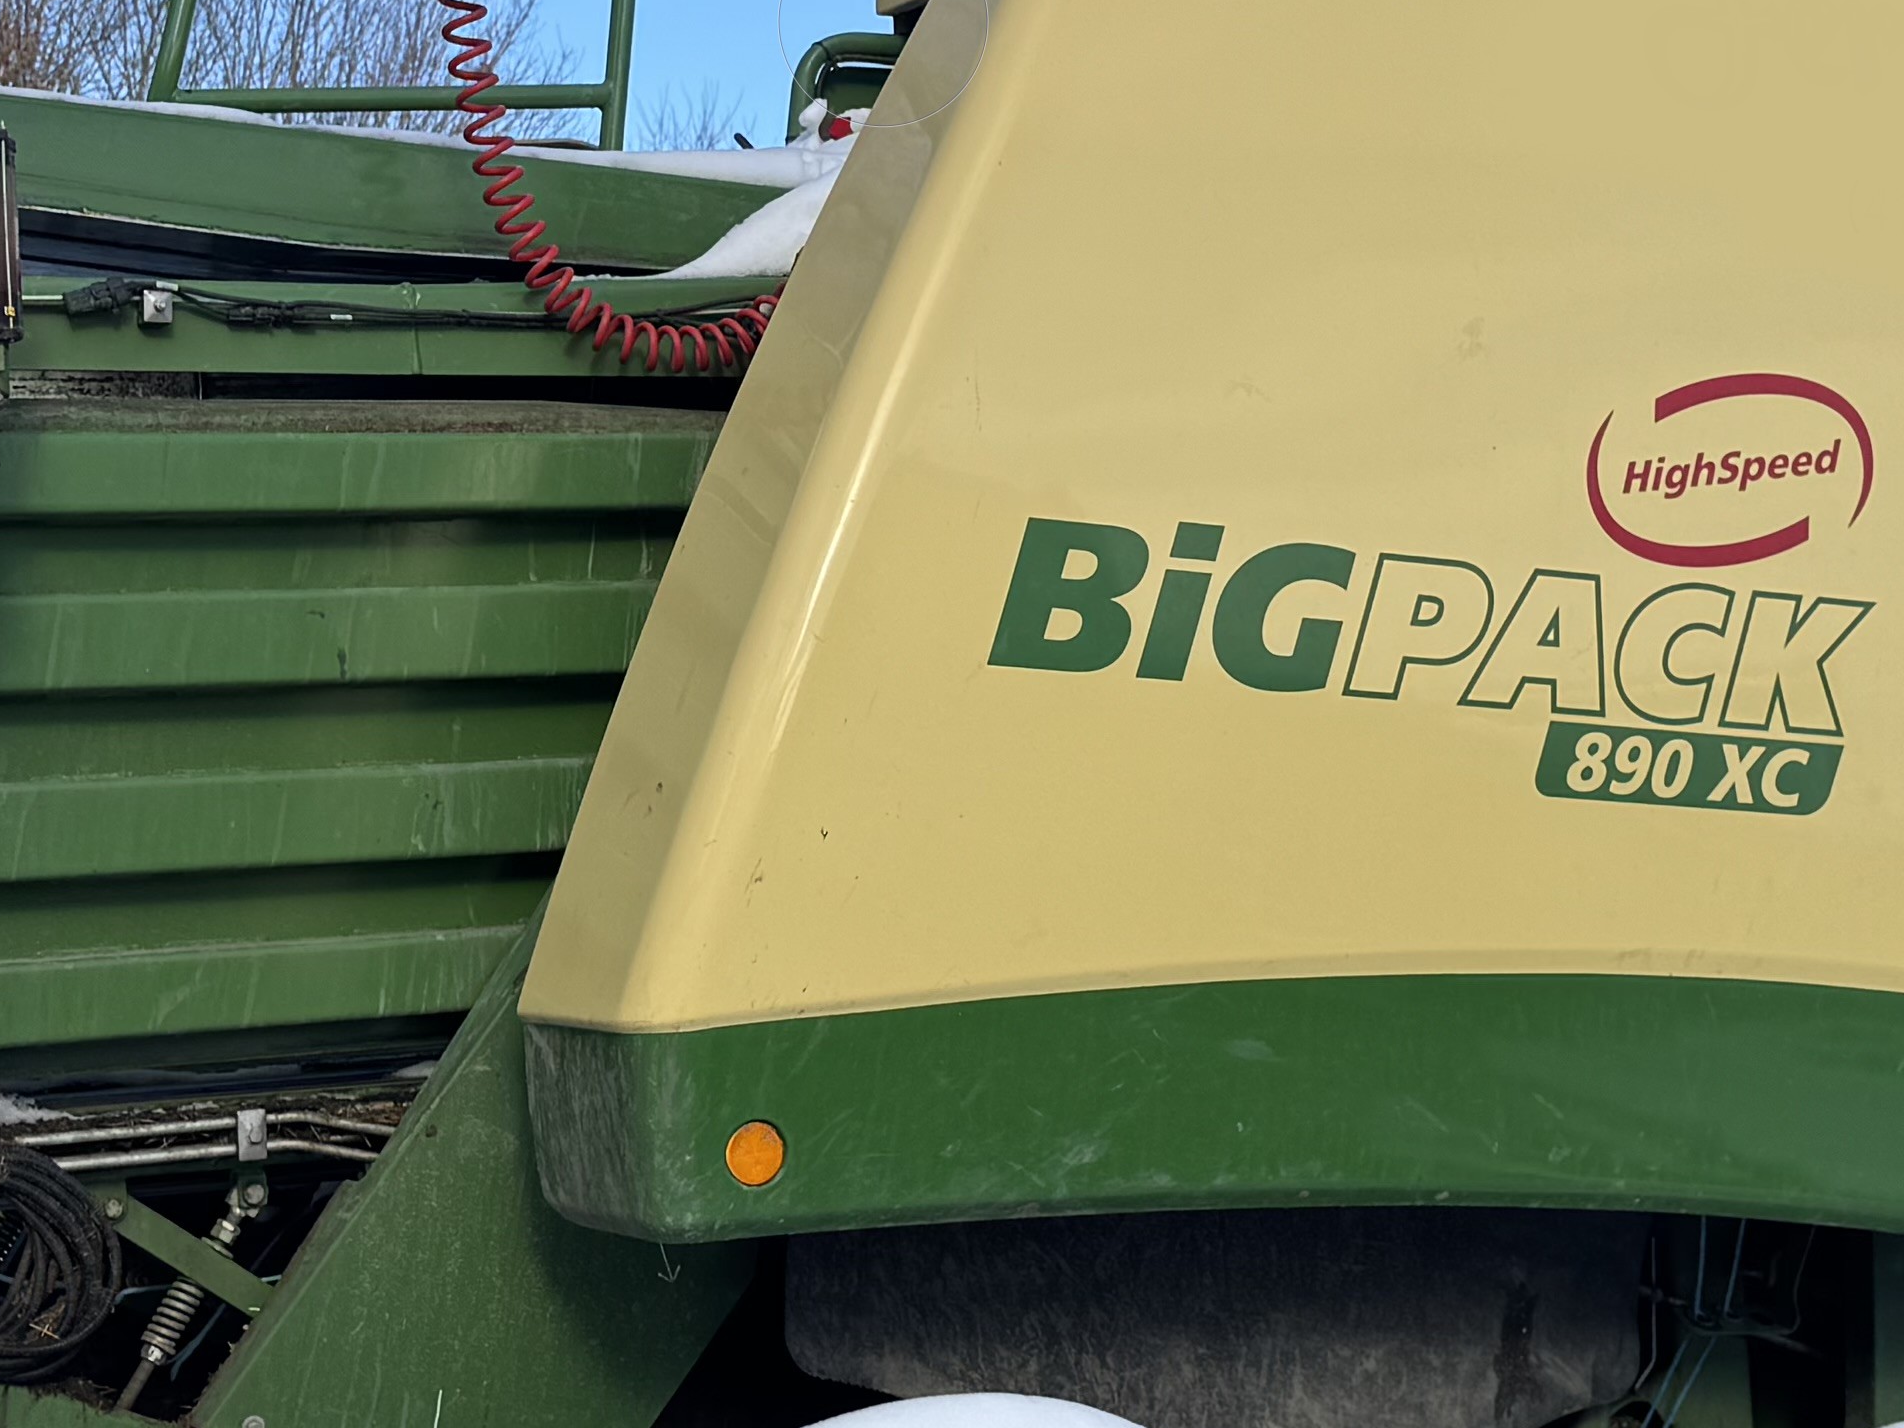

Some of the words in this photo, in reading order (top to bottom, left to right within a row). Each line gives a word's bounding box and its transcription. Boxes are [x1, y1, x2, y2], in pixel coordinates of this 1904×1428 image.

[1622, 439, 1841, 499] HighSpeed
[1566, 732, 1693, 801] 890
[1707, 745, 1811, 808] XC
